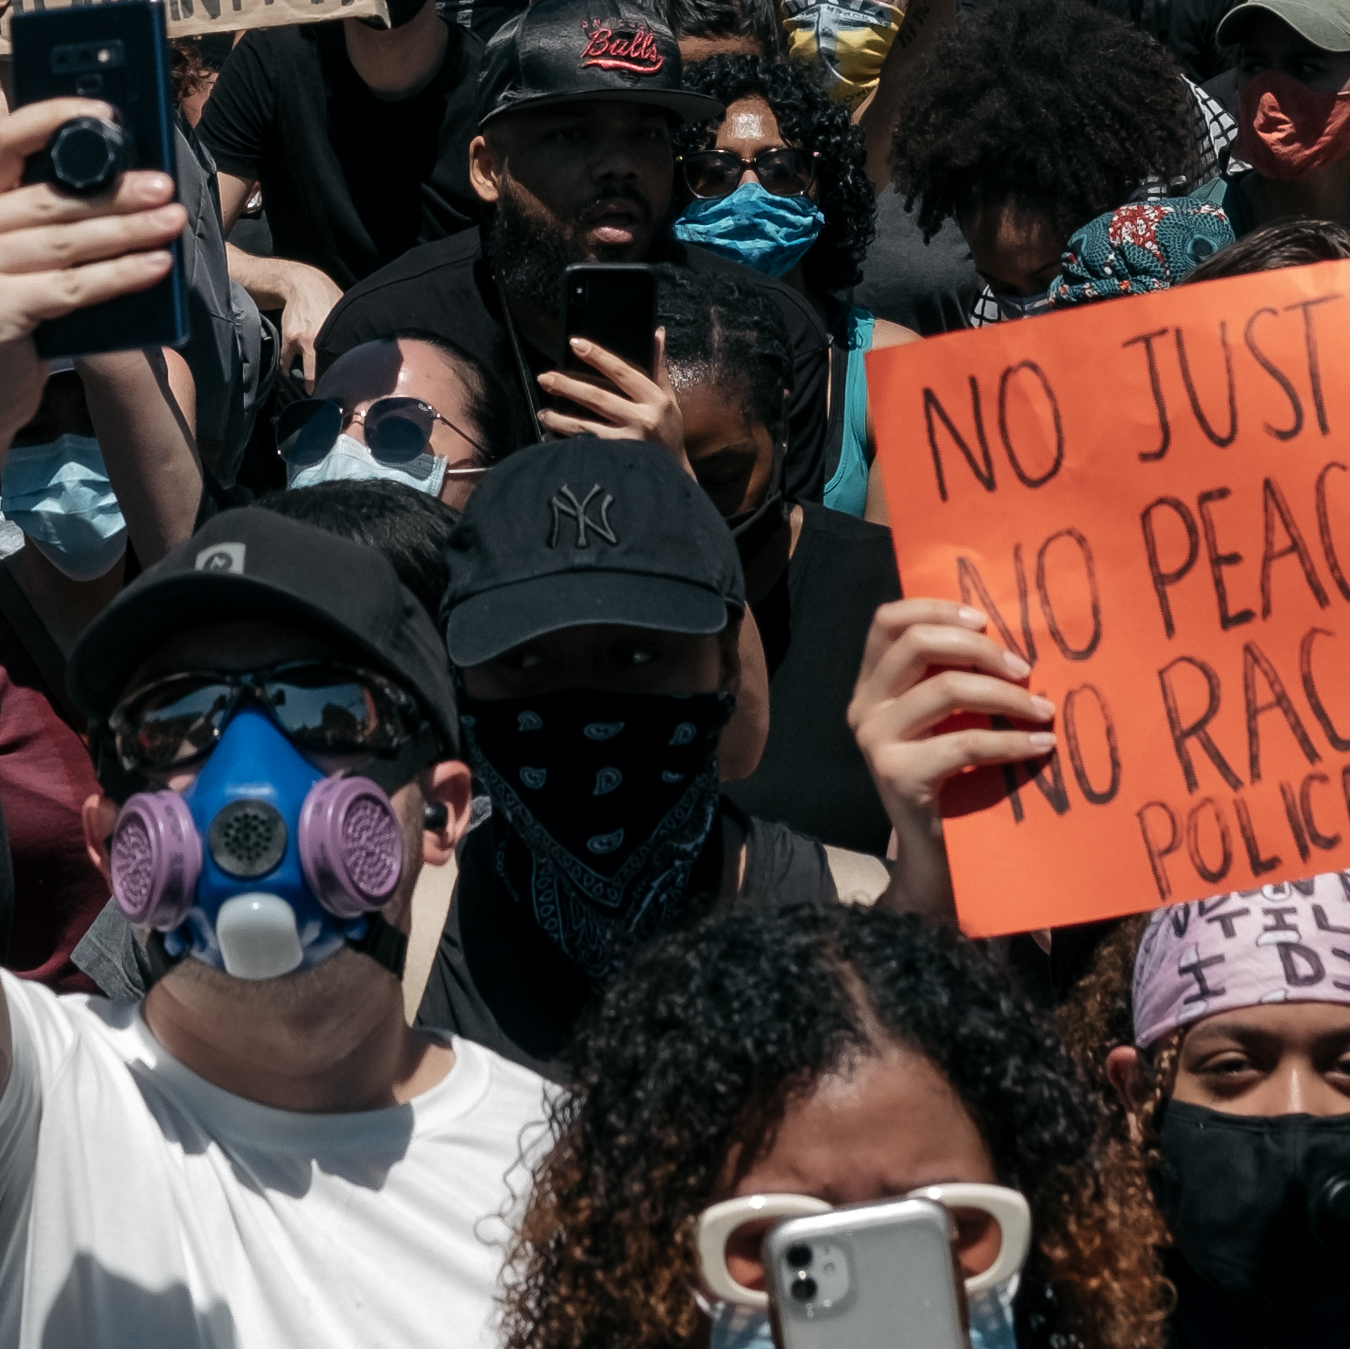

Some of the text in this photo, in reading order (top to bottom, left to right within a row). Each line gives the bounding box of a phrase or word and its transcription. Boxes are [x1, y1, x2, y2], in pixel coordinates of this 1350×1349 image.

[579, 27, 662, 65] Bulls
[920, 358, 1064, 502] NO
[547, 481, 620, 551] NY
[956, 528, 1101, 670] NO
